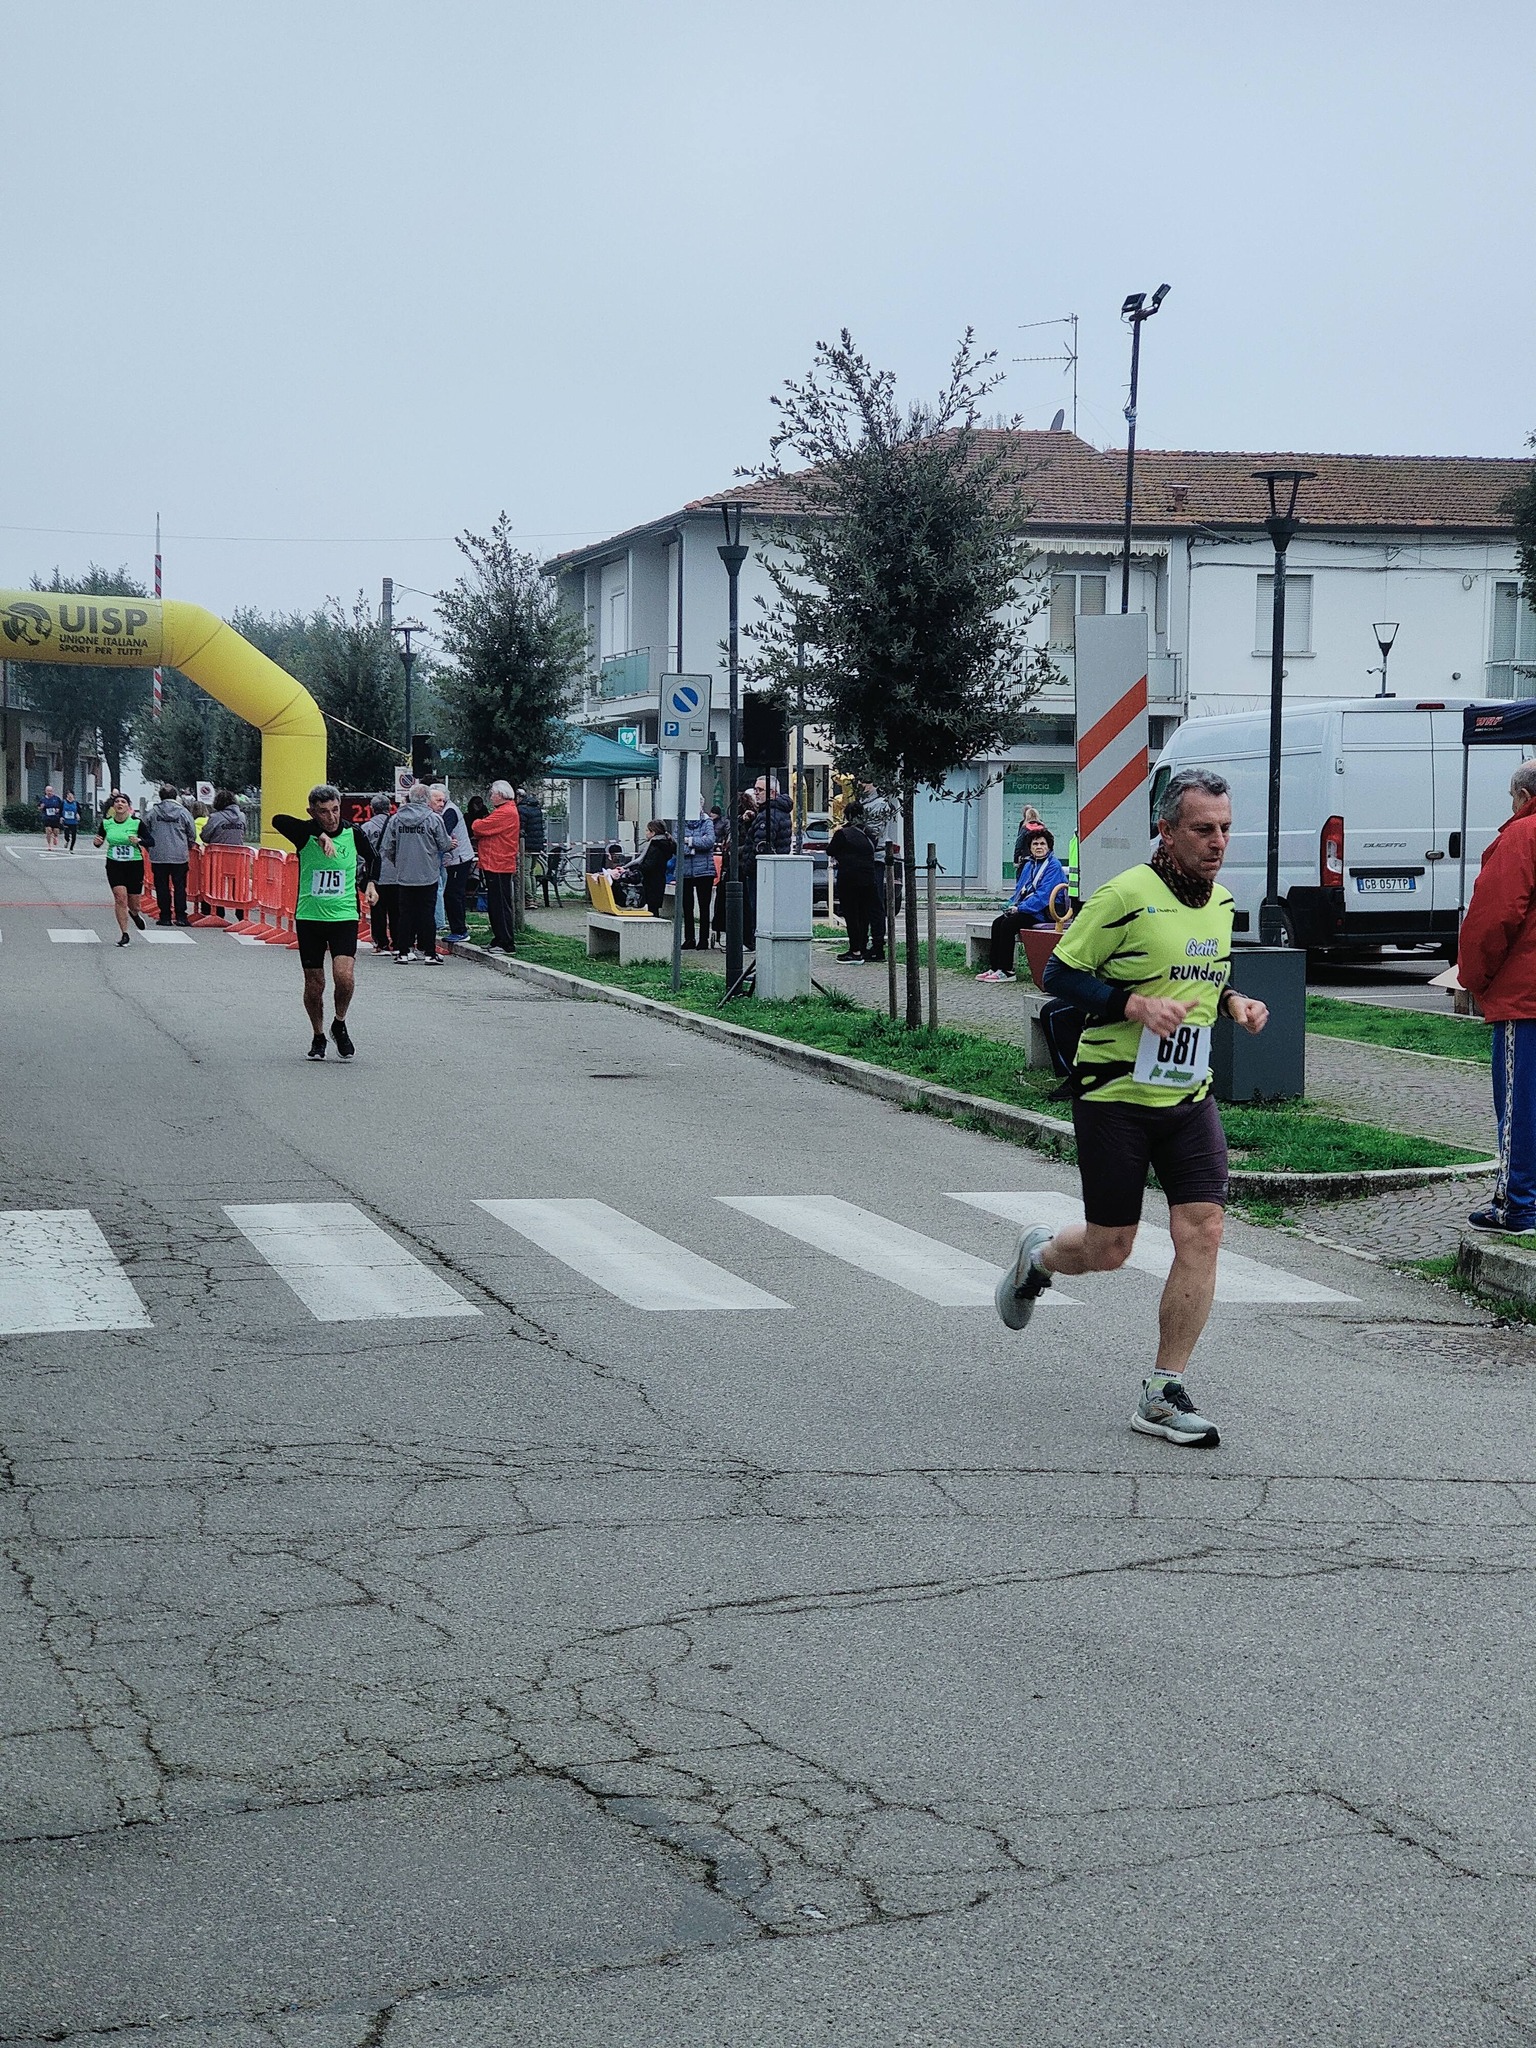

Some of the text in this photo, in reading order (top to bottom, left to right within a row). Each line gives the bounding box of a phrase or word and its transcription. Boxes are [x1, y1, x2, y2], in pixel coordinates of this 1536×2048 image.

[58, 604, 148, 636] UISP
[59, 634, 149, 648] UNIONE ITALIANA
[59, 643, 143, 656] SPORT PER TUTTI
[667, 724, 677, 735] P
[1012, 782, 1050, 790] Farmacia
[319, 870, 340, 887] 775
[1364, 878, 1408, 889] GB 057TP
[1185, 938, 1218, 957] Gatti
[1157, 1026, 1200, 1066] 681
